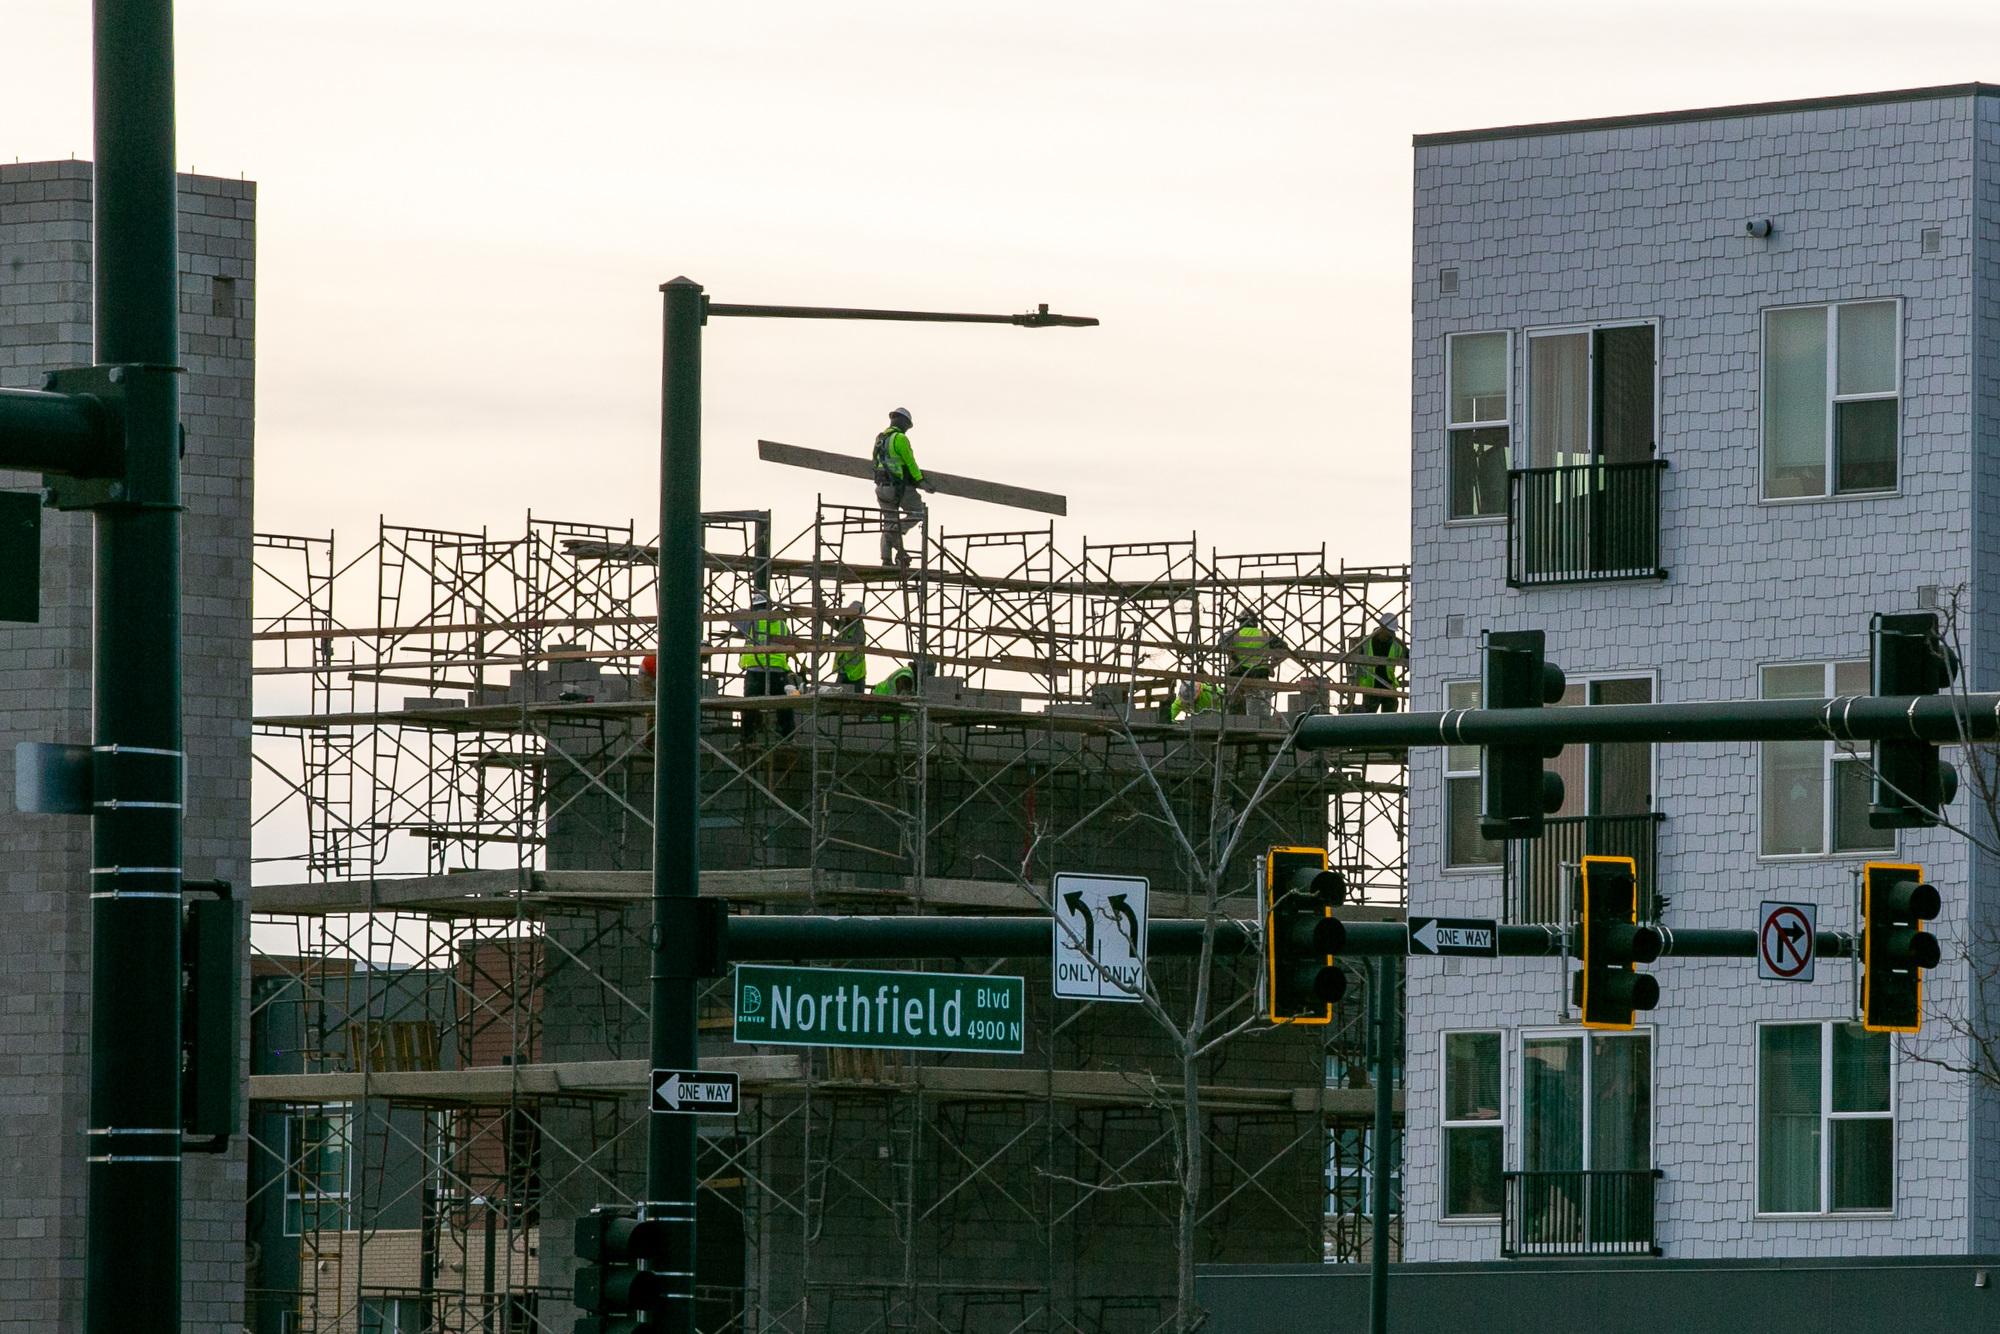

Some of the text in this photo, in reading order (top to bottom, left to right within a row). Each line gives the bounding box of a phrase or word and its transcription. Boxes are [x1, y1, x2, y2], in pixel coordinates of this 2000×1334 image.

[1436, 930, 1488, 945] ONE WAY
[1059, 963, 1096, 982] ONLY
[977, 988, 1010, 1009] Blvd
[738, 1015, 765, 1023] DENVER
[770, 984, 961, 1037] Northfield
[967, 1020, 1020, 1041] 4900 N
[678, 1084, 730, 1100] ONE WAY
